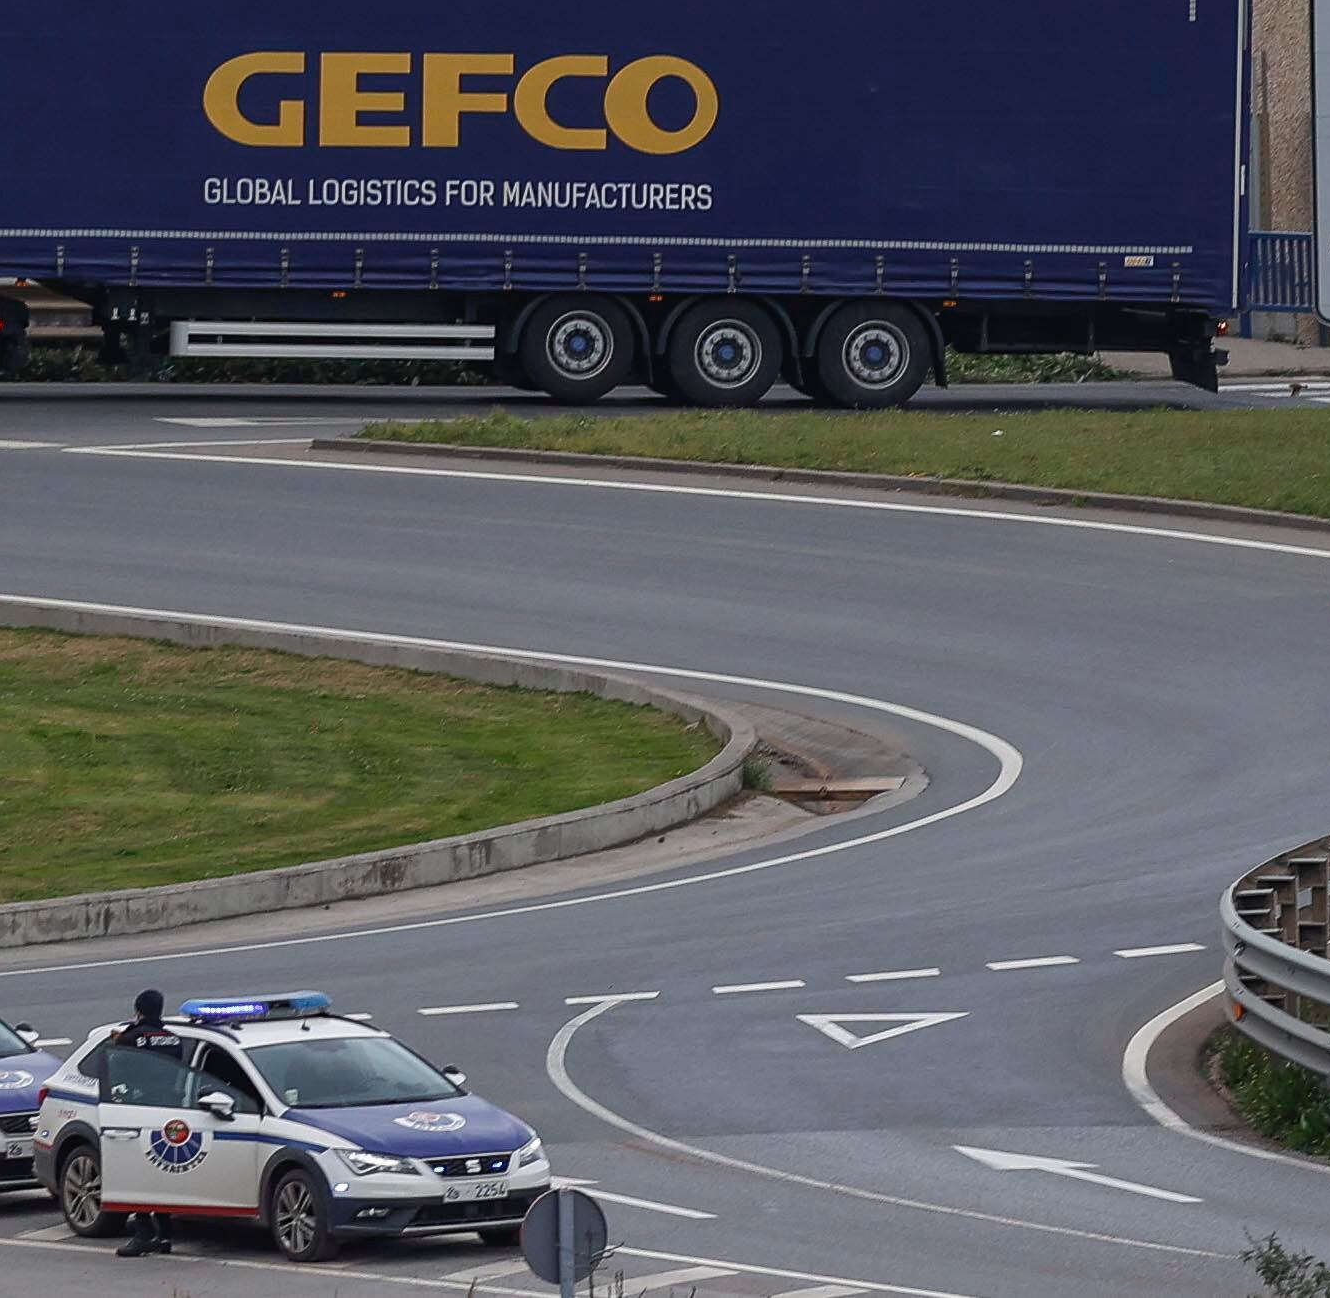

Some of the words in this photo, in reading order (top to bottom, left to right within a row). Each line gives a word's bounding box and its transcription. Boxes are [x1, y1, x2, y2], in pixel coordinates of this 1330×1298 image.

[204, 177, 302, 205] GLOBAL
[308, 179, 437, 206] LOGISTICS
[445, 180, 495, 206] FOR
[502, 181, 712, 210] MANUFACTURERS
